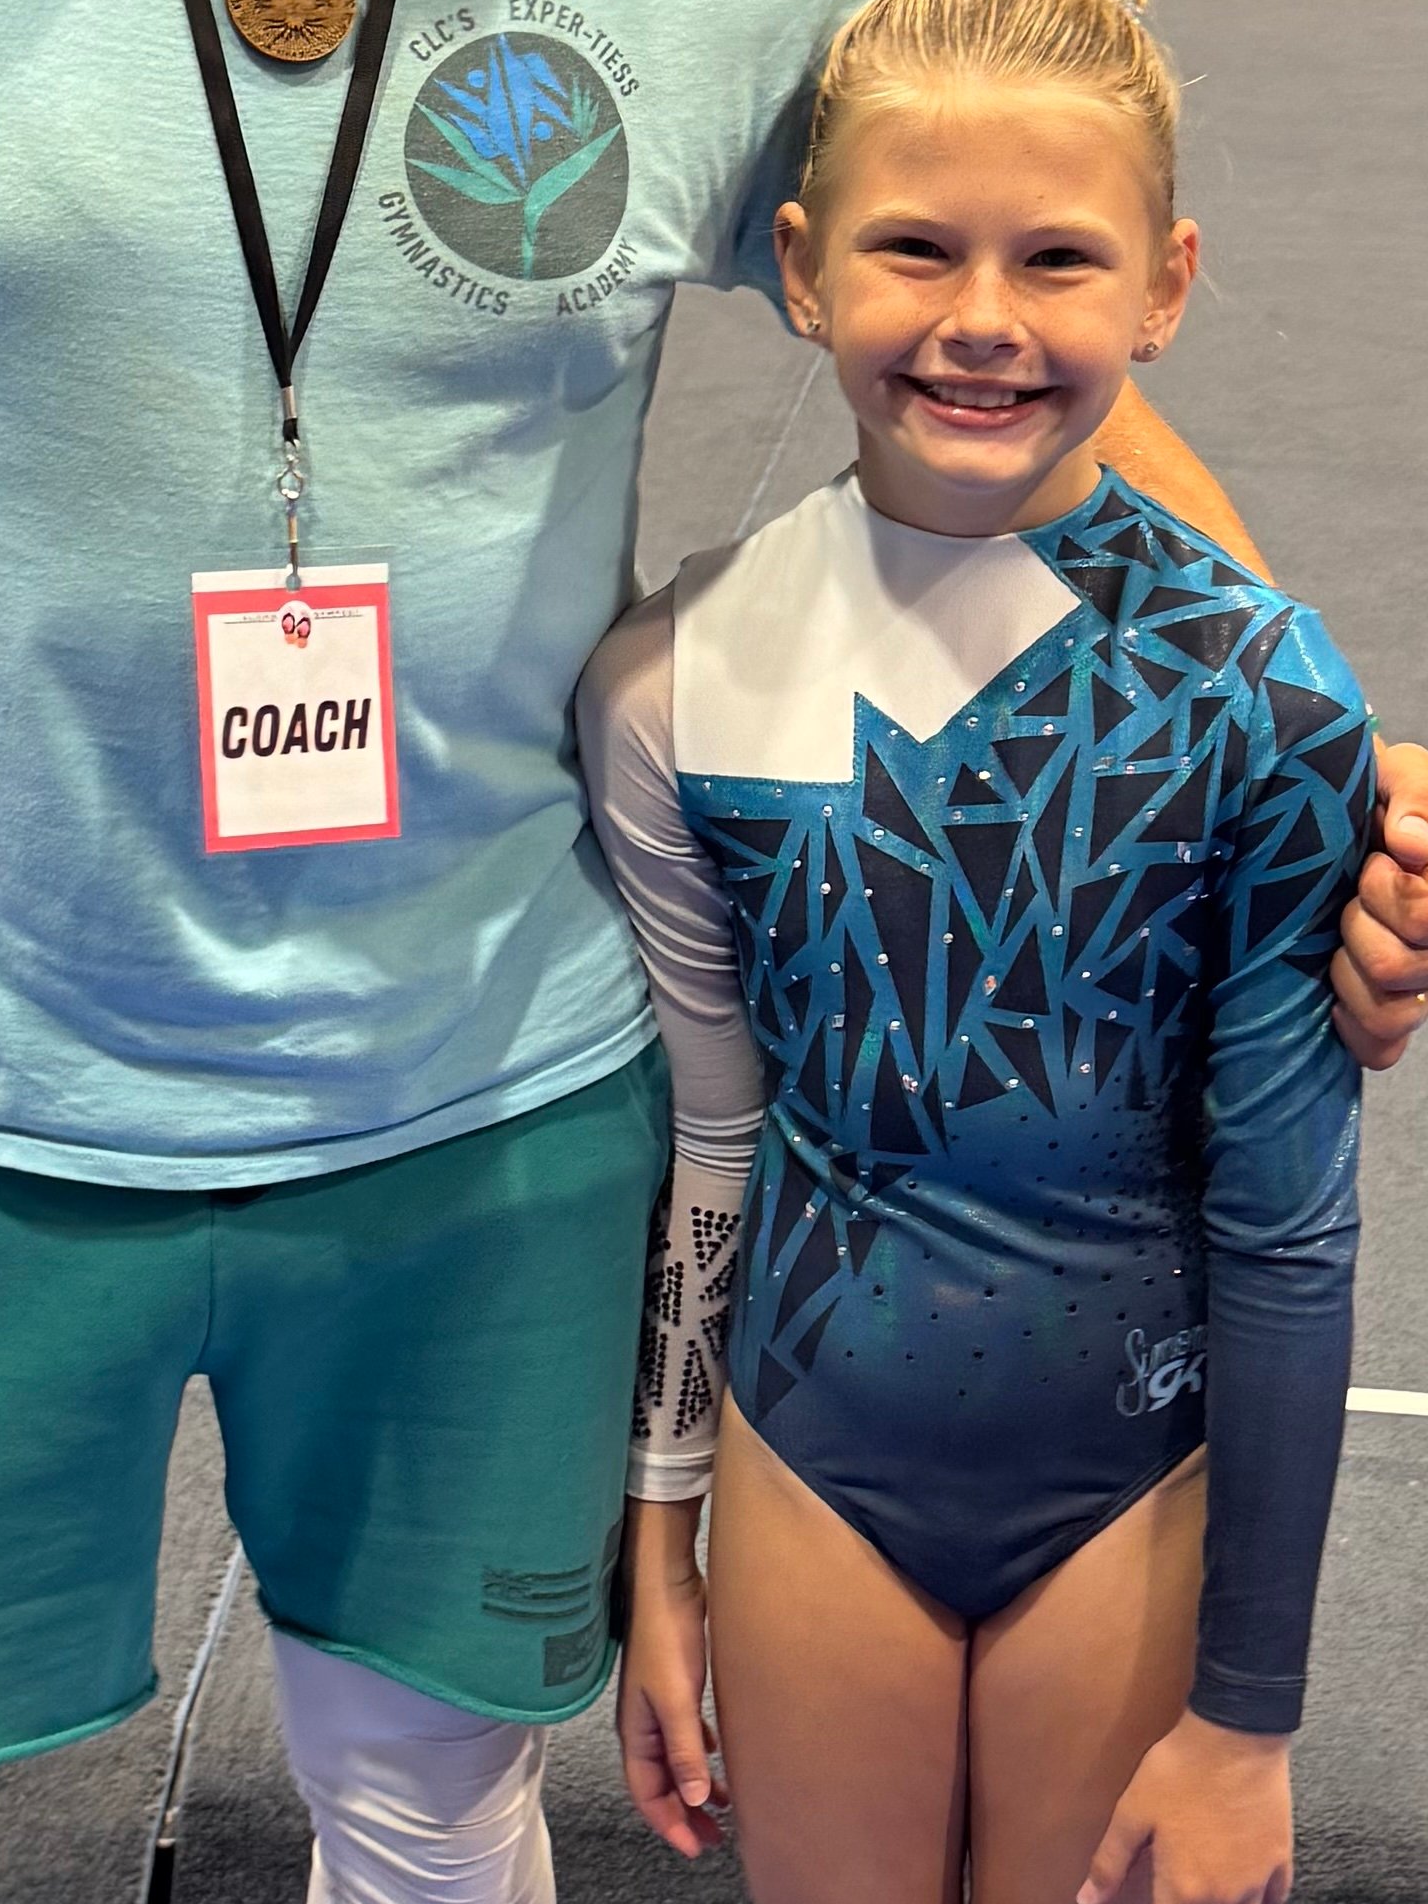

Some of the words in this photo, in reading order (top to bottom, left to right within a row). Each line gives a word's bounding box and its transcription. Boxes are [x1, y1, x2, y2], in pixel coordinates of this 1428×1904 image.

[408, 7, 476, 62] CLC'S
[378, 190, 511, 316] GYMNASTICS
[556, 236, 639, 317] ACADEMY
[222, 697, 372, 759] COACH
